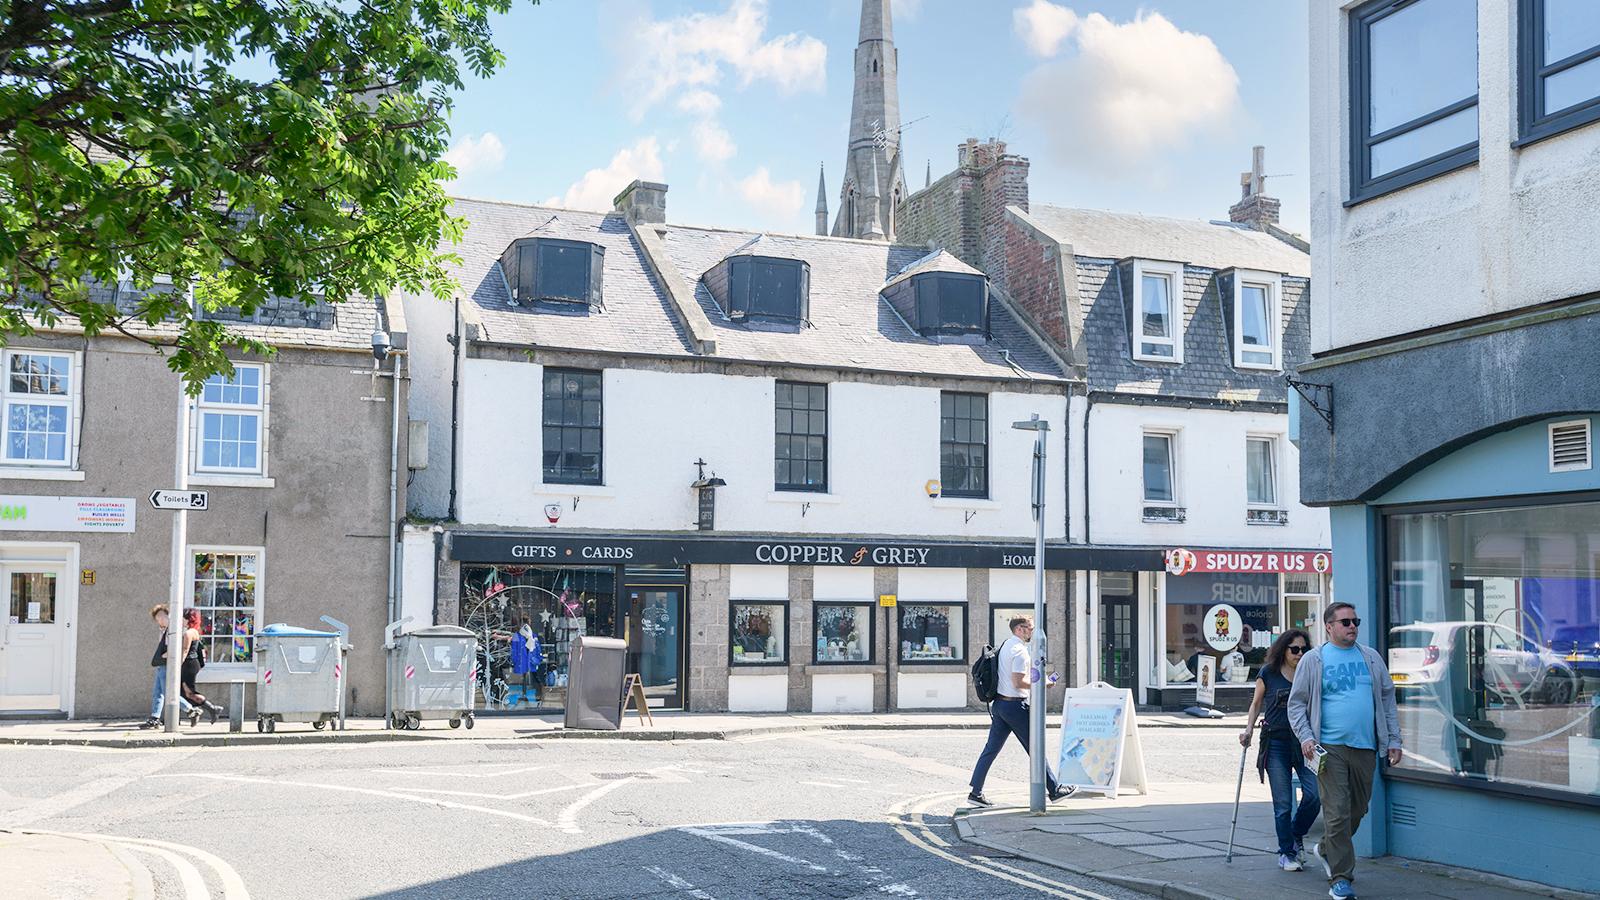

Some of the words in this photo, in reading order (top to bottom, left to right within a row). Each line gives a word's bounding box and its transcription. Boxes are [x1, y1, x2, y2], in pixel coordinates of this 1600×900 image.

[163, 495, 189, 503] Toilets
[0, 503, 27, 521] AM
[511, 545, 557, 559] GIFTS
[581, 546, 634, 559] CARDS
[755, 544, 844, 564] COPPER
[871, 546, 931, 566] GREY
[1206, 553, 1264, 571] SPUDZ
[1267, 554, 1279, 571] R
[1283, 553, 1305, 571] US
[1325, 662, 1370, 680] GAM
